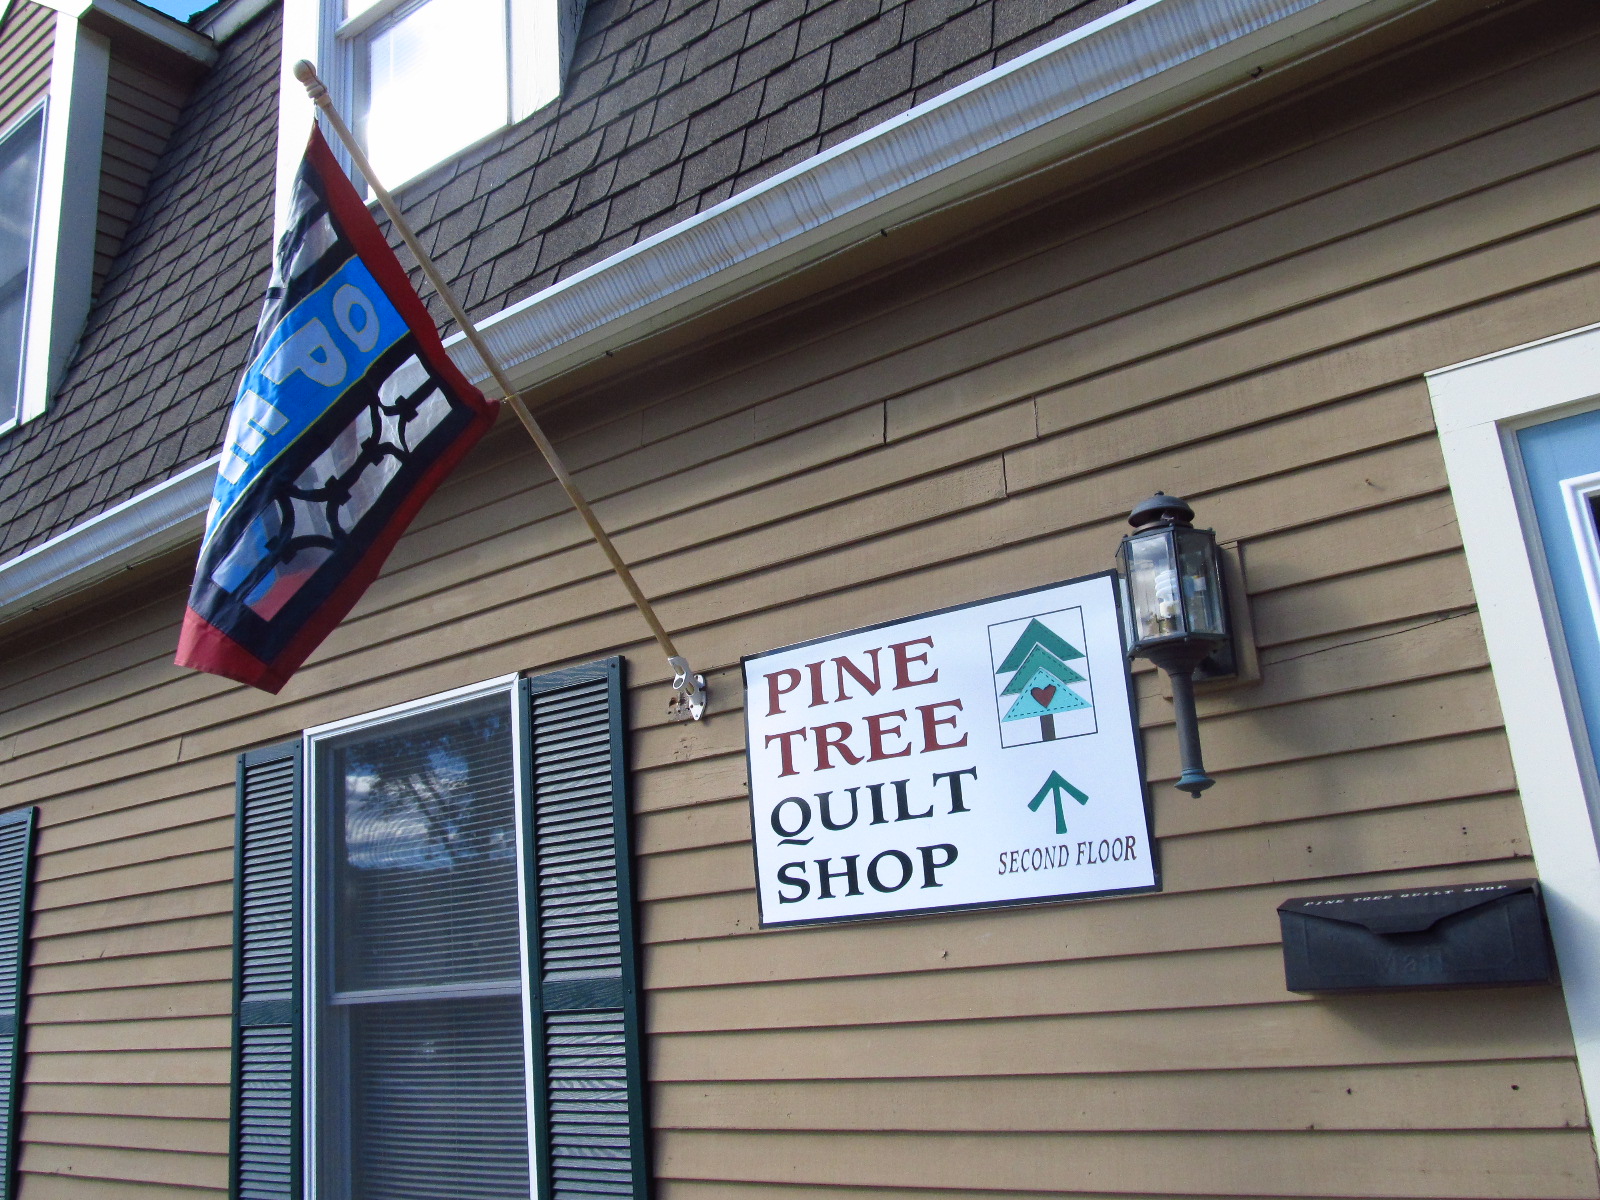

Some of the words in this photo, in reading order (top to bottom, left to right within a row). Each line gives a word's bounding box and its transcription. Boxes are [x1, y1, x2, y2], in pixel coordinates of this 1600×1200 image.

[204, 283, 380, 531] OPE
[763, 635, 939, 718] PINE
[764, 698, 969, 779] TREE
[770, 765, 978, 847] QUILT
[776, 843, 959, 905] SHOP
[998, 844, 1070, 876] SECOND
[1075, 835, 1137, 867] FLOOR
[1303, 899, 1345, 907] PINE
